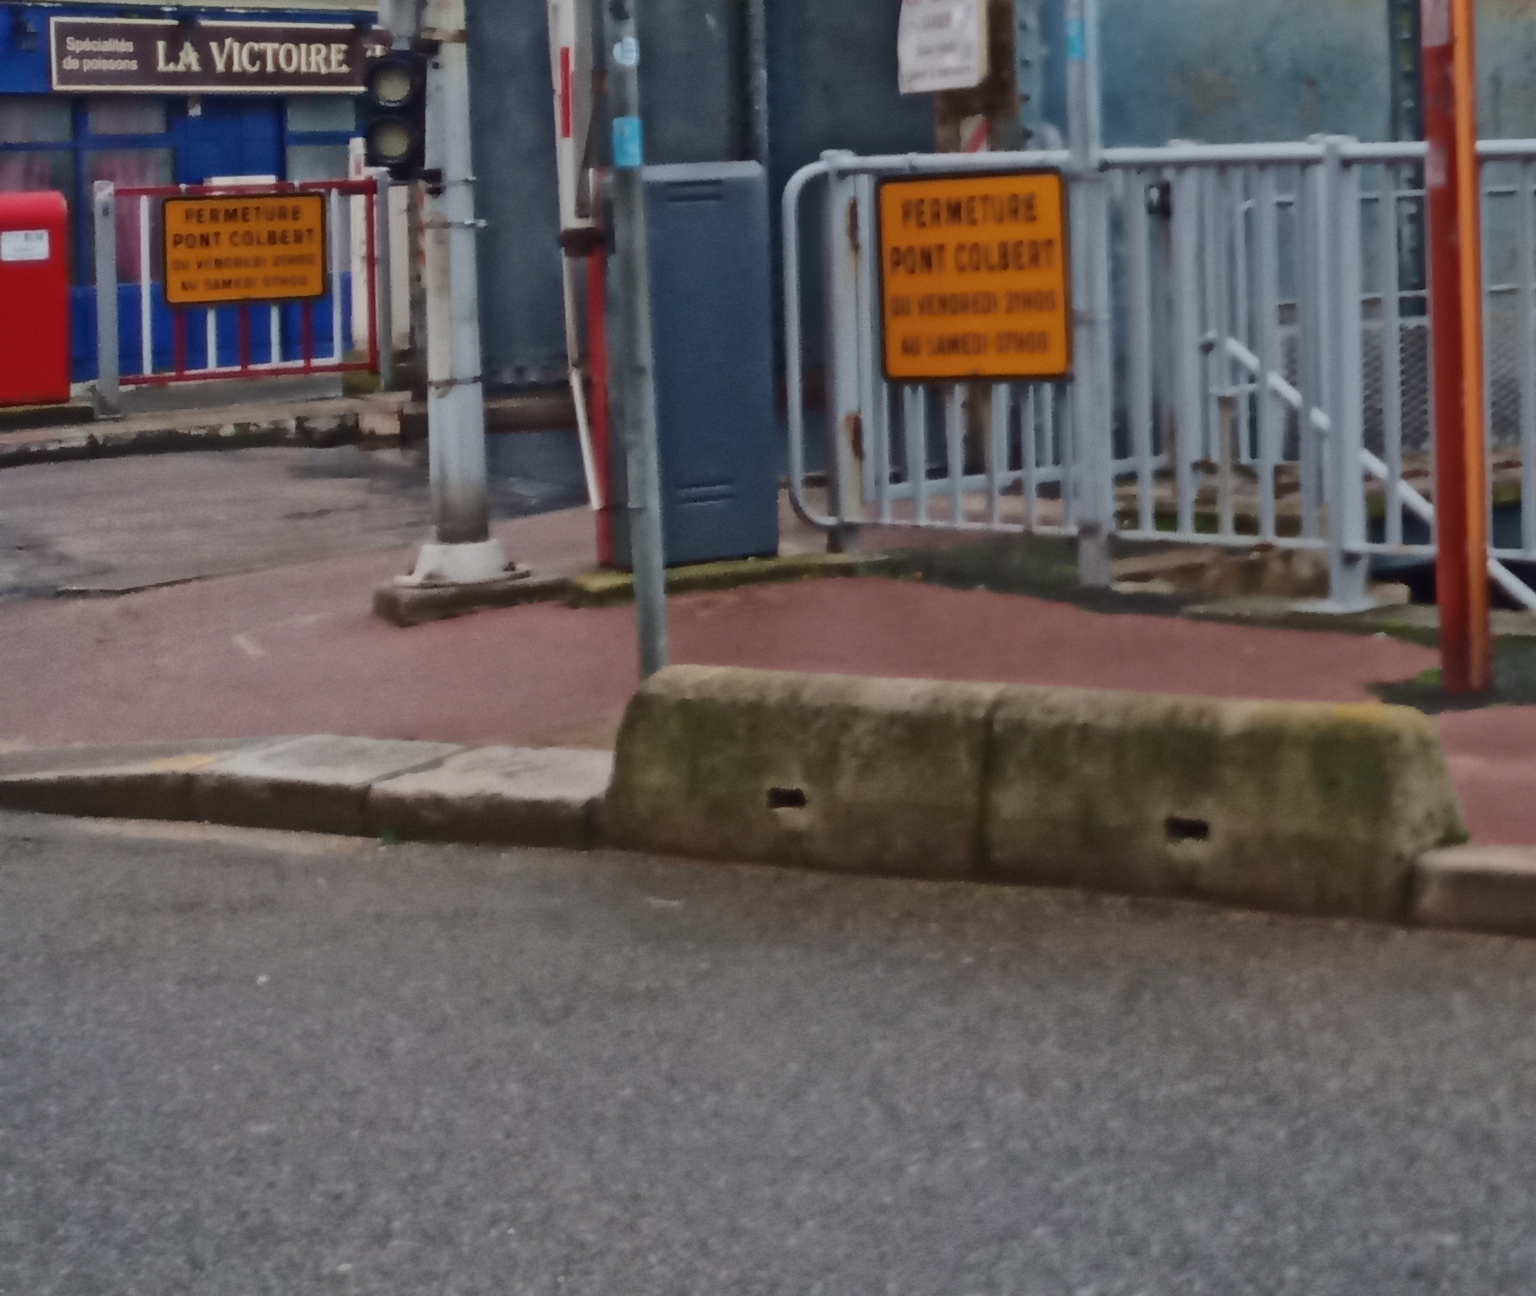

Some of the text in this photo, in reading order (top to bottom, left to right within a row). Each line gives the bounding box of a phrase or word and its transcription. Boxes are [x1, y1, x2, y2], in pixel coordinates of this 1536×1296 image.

[65, 35, 134, 54] Spécialités
[62, 56, 138, 73] de poissons
[156, 37, 351, 74] LA VICTOIRE
[185, 205, 301, 223] FERMETURE
[902, 192, 1037, 228] FERMETURE
[172, 228, 314, 248] PONT COLBERT
[889, 239, 1054, 274] PONT COLBERT
